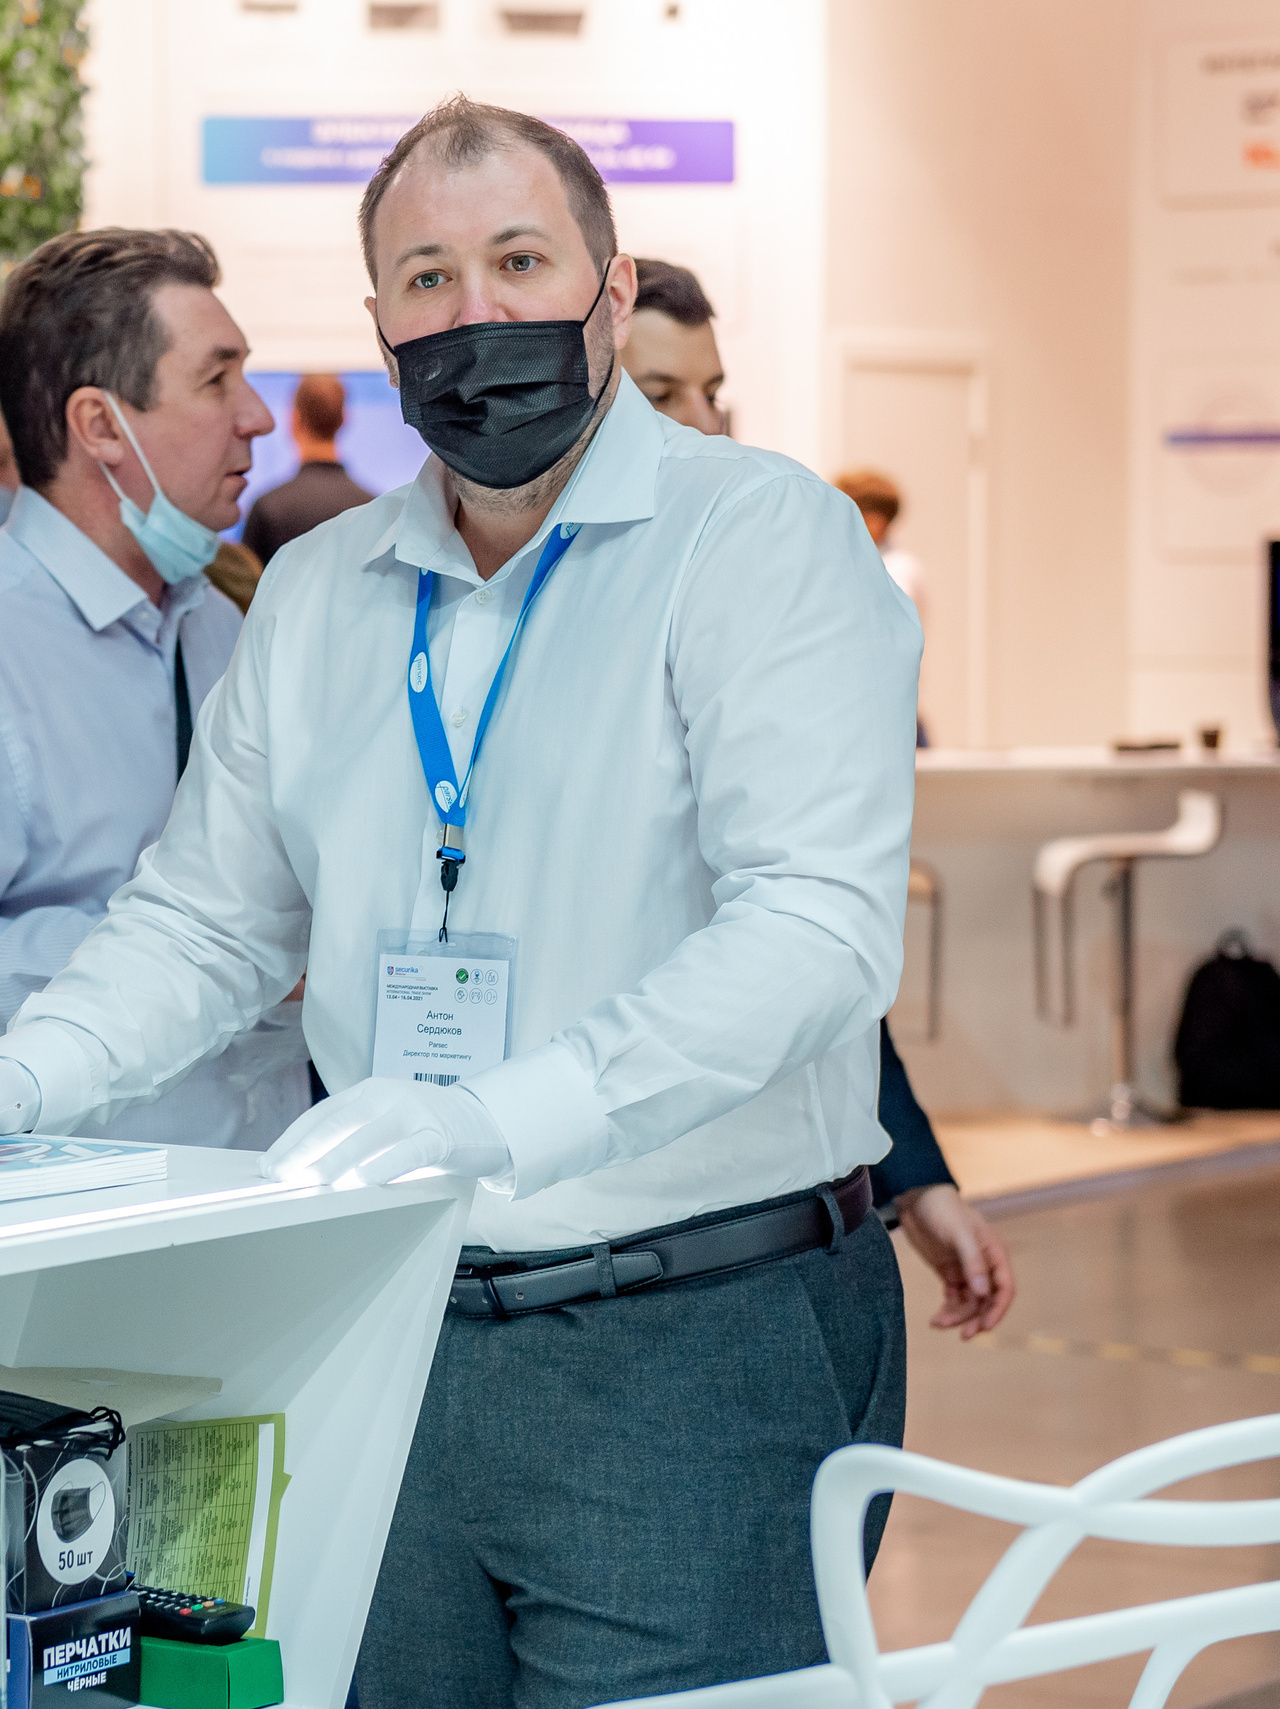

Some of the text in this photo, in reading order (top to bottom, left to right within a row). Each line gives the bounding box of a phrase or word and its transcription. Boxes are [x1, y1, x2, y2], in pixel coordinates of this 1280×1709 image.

[435, 785, 453, 805] parse
[395, 966, 419, 974] securika
[426, 1010, 454, 1021] Антон
[417, 1023, 462, 1036] Сердюков
[428, 1041, 448, 1049] Parsec
[402, 1049, 431, 1058] Директор
[439, 1053, 472, 1061] маркетингу
[58, 1549, 74, 1571] 50
[43, 1626, 132, 1670] ПЕРЧАТКИ
[56, 1653, 118, 1680] НИТРИЛОВЫЕ
[67, 1671, 107, 1693] ЧЁРНЫЕ
